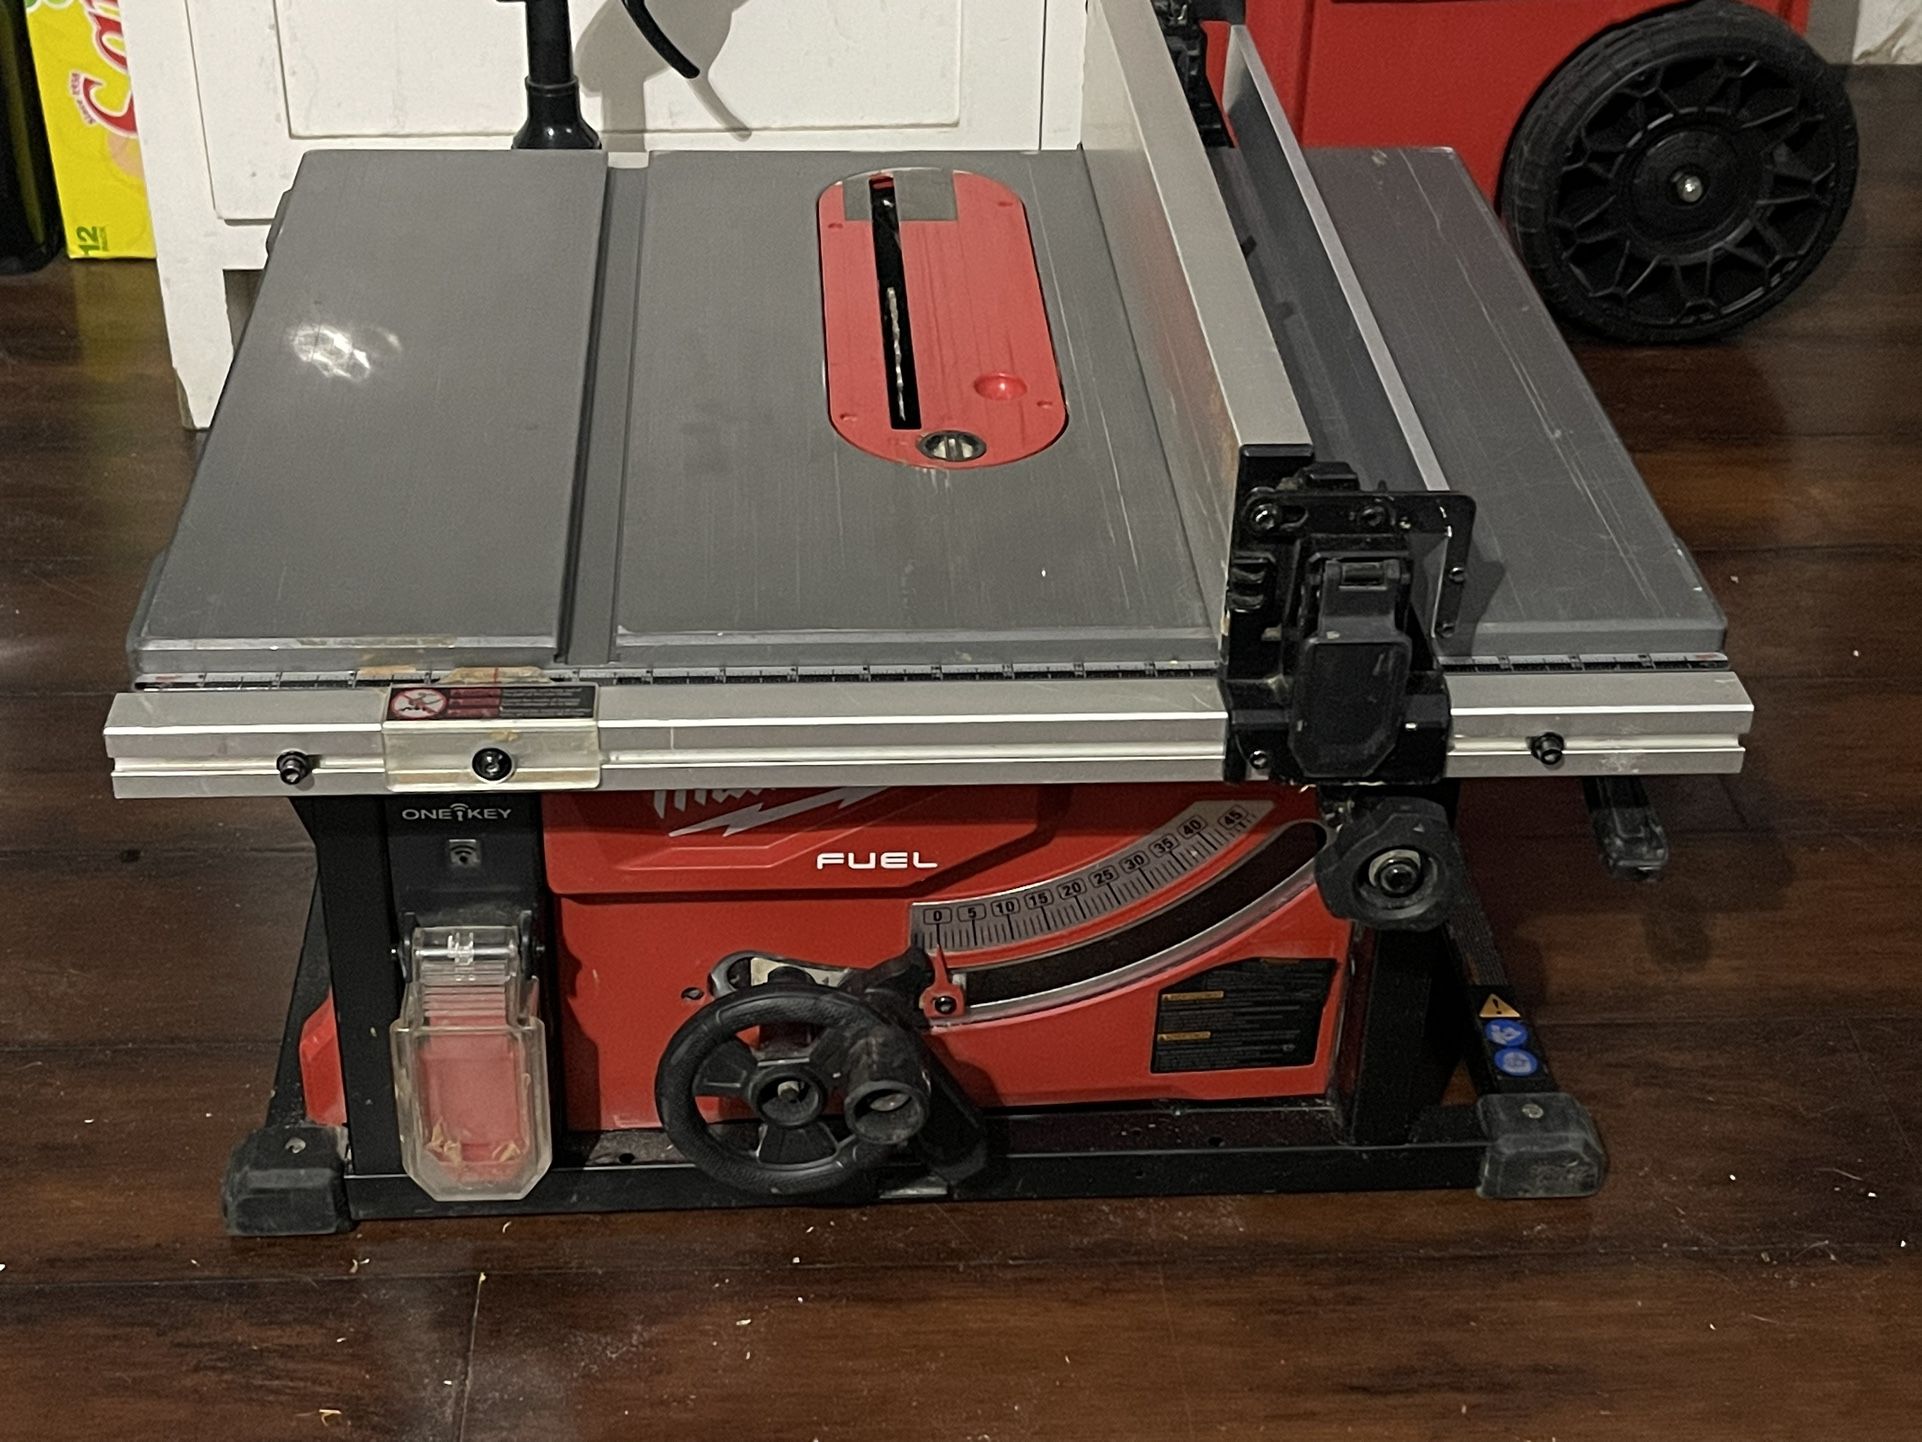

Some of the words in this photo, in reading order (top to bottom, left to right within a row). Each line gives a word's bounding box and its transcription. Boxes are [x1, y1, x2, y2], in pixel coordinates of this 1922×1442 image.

[76, 226, 100, 255] 12
[816, 851, 938, 870] FUEL
[933, 910, 943, 922] 0
[967, 907, 977, 918] 5
[995, 901, 1015, 914] 10
[1029, 892, 1048, 905] 15
[1063, 882, 1082, 897] 20
[1094, 869, 1114, 885] 25
[1124, 855, 1145, 870] 30
[1153, 837, 1174, 853] 35
[1183, 819, 1202, 835] 40
[1223, 809, 1243, 826] 45
